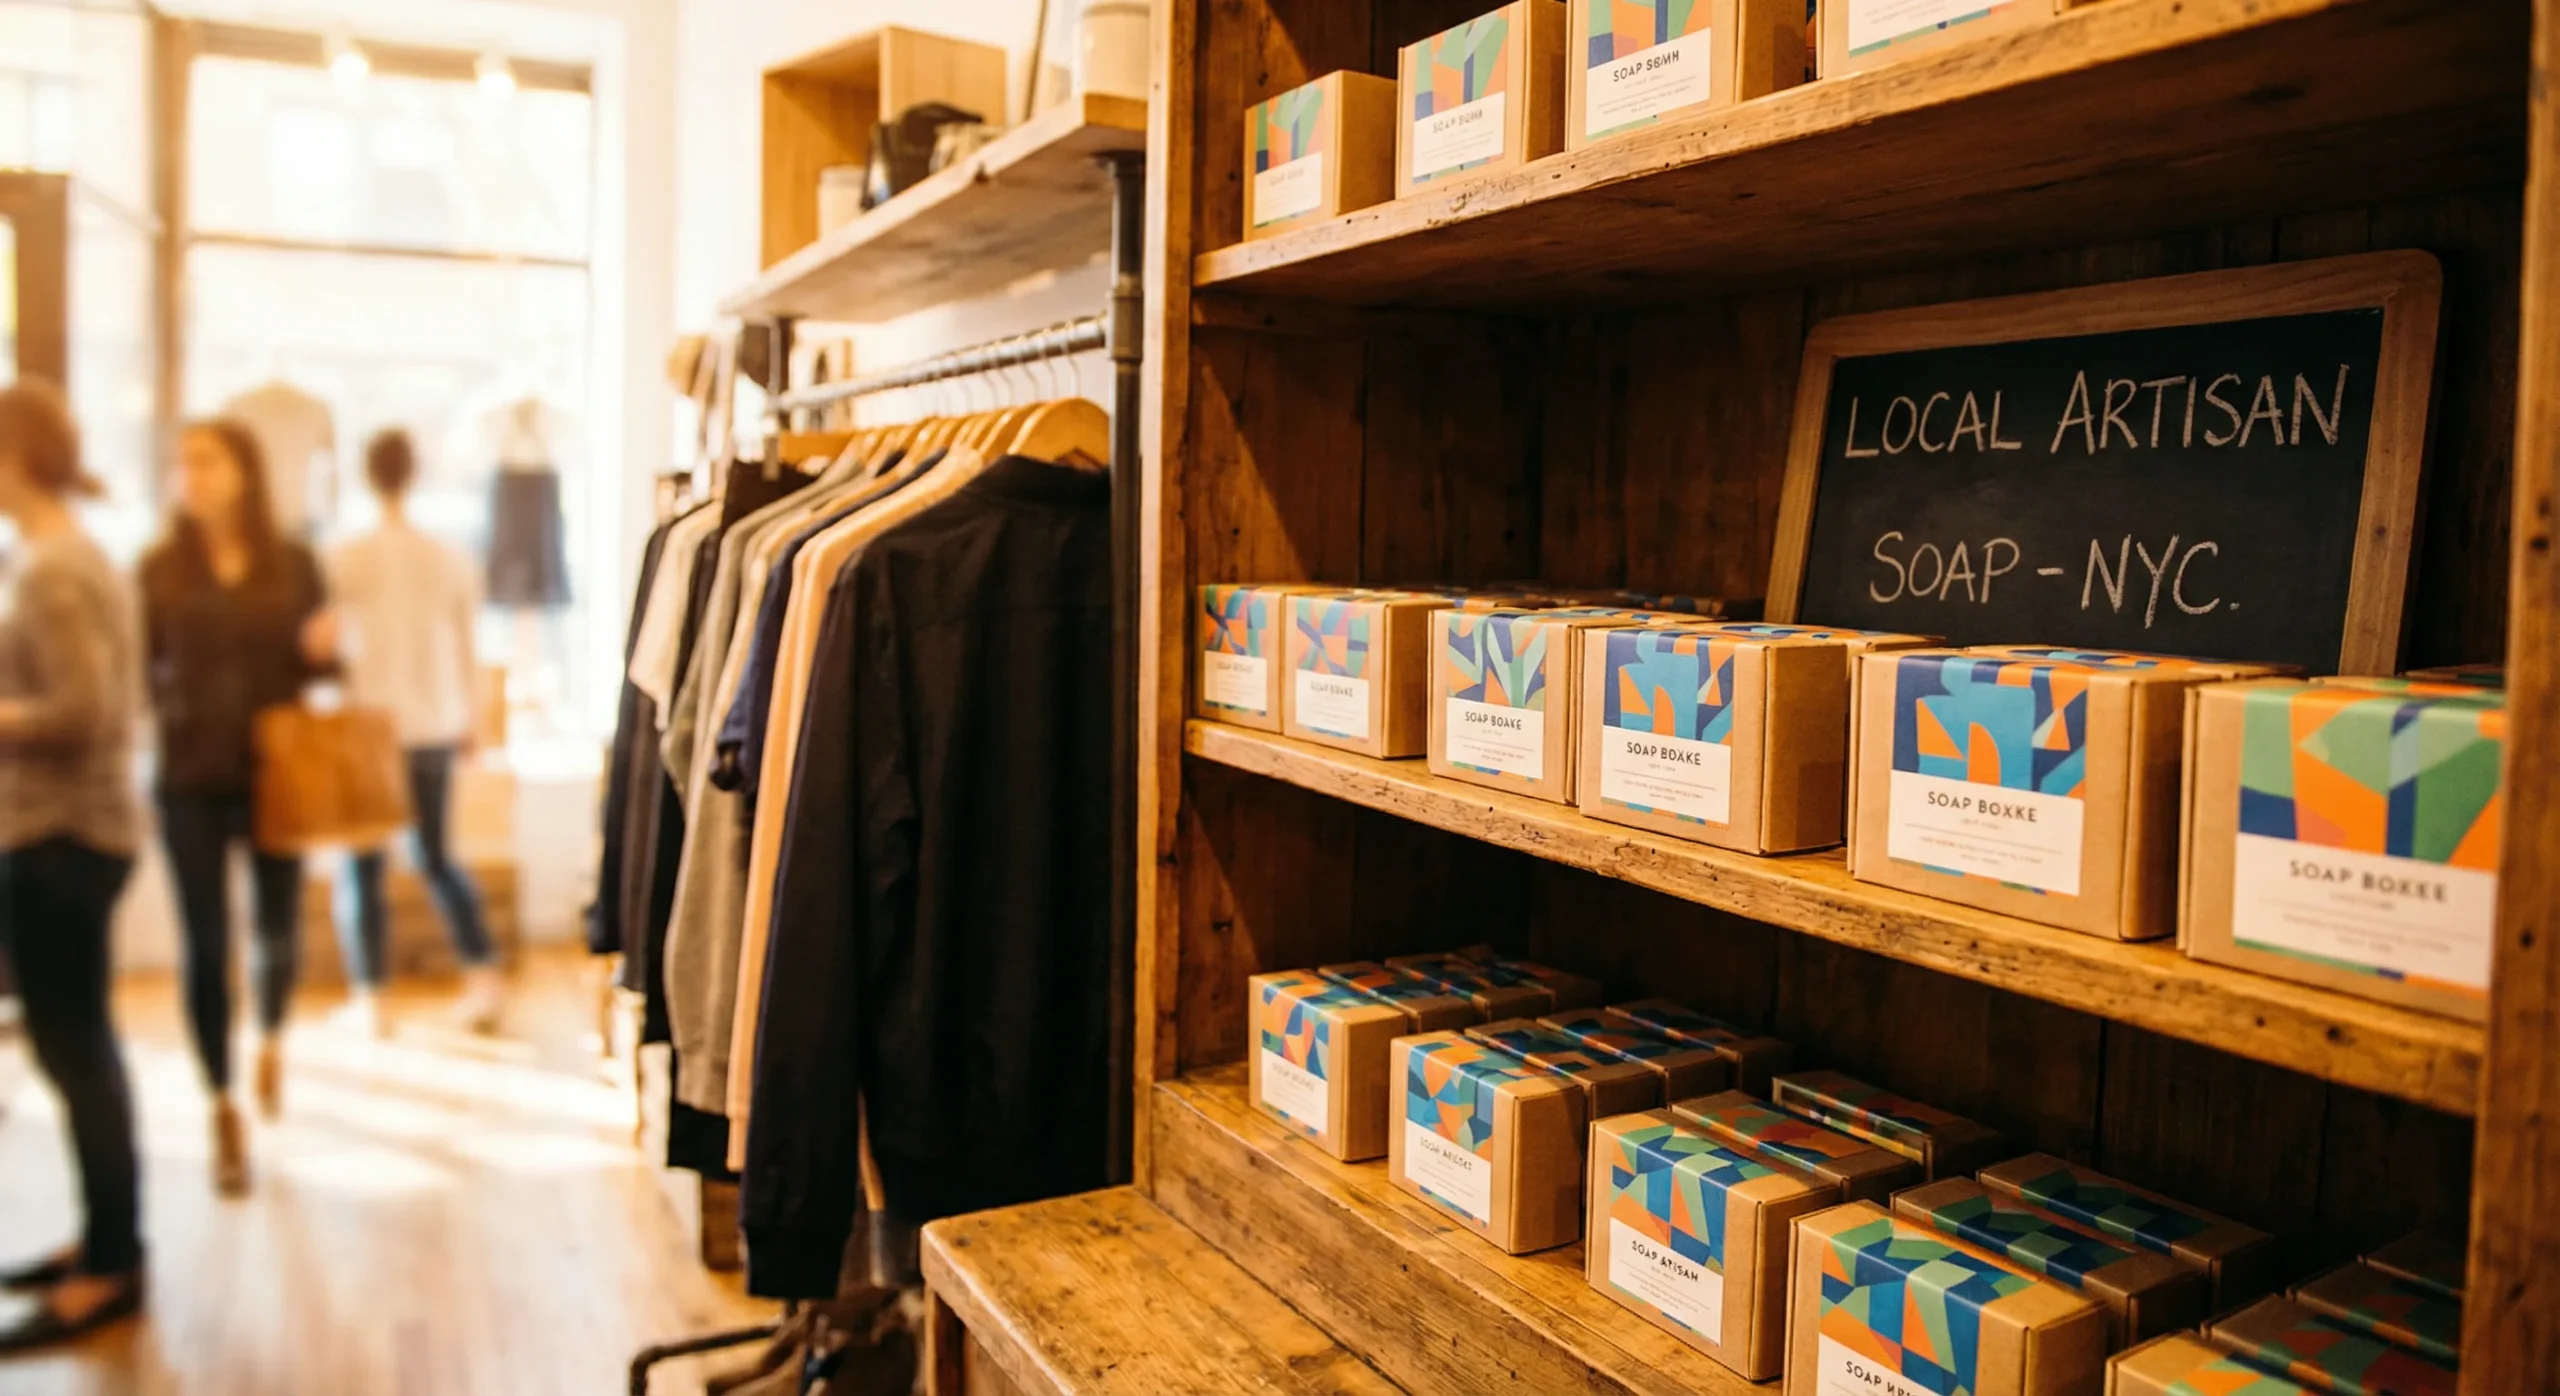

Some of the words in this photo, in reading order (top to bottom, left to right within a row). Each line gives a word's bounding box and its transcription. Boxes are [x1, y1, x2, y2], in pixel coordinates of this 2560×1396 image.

[1613, 62, 1643, 82] SOAP
[1844, 389, 2022, 458] LOCAL
[2050, 363, 2350, 455] ARTISAN
[1869, 531, 2021, 603] SOAP
[1465, 711, 1489, 724] SOAP
[1626, 741, 1658, 757] SOAP
[1928, 791, 1972, 810] SOAP
[2290, 859, 2353, 884] SOAP
[1845, 1360, 1882, 1386] SOAP
